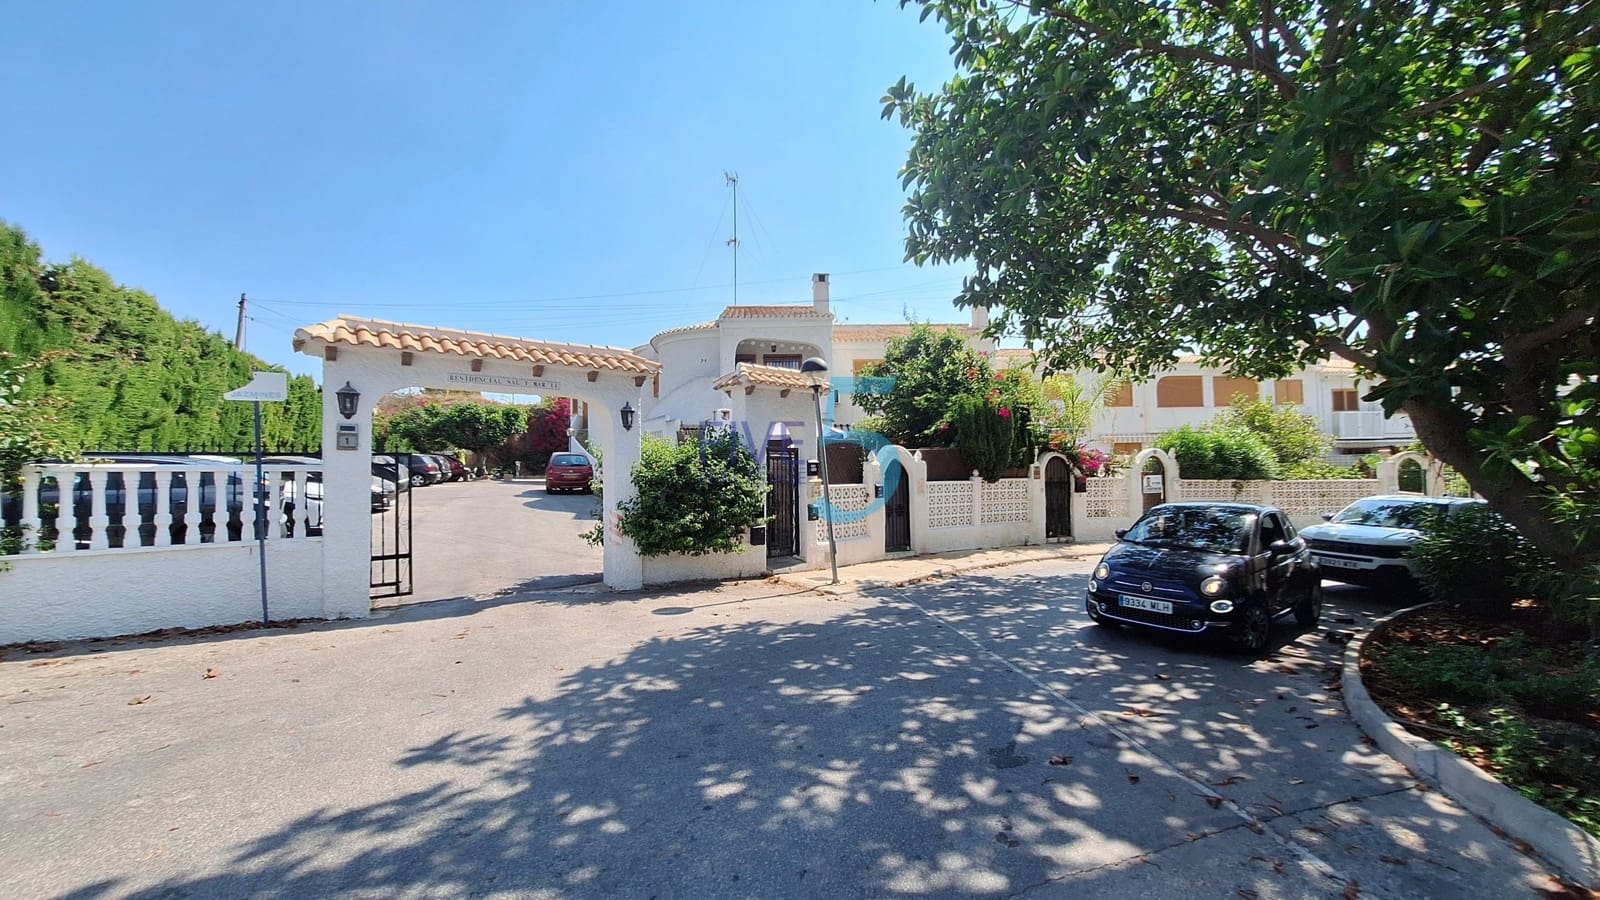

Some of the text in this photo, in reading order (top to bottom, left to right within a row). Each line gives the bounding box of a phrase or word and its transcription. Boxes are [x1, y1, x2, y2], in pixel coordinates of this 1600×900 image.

[449, 375, 503, 385] RESIDENCIAL
[1124, 597, 1170, 612] 9334 MLH
